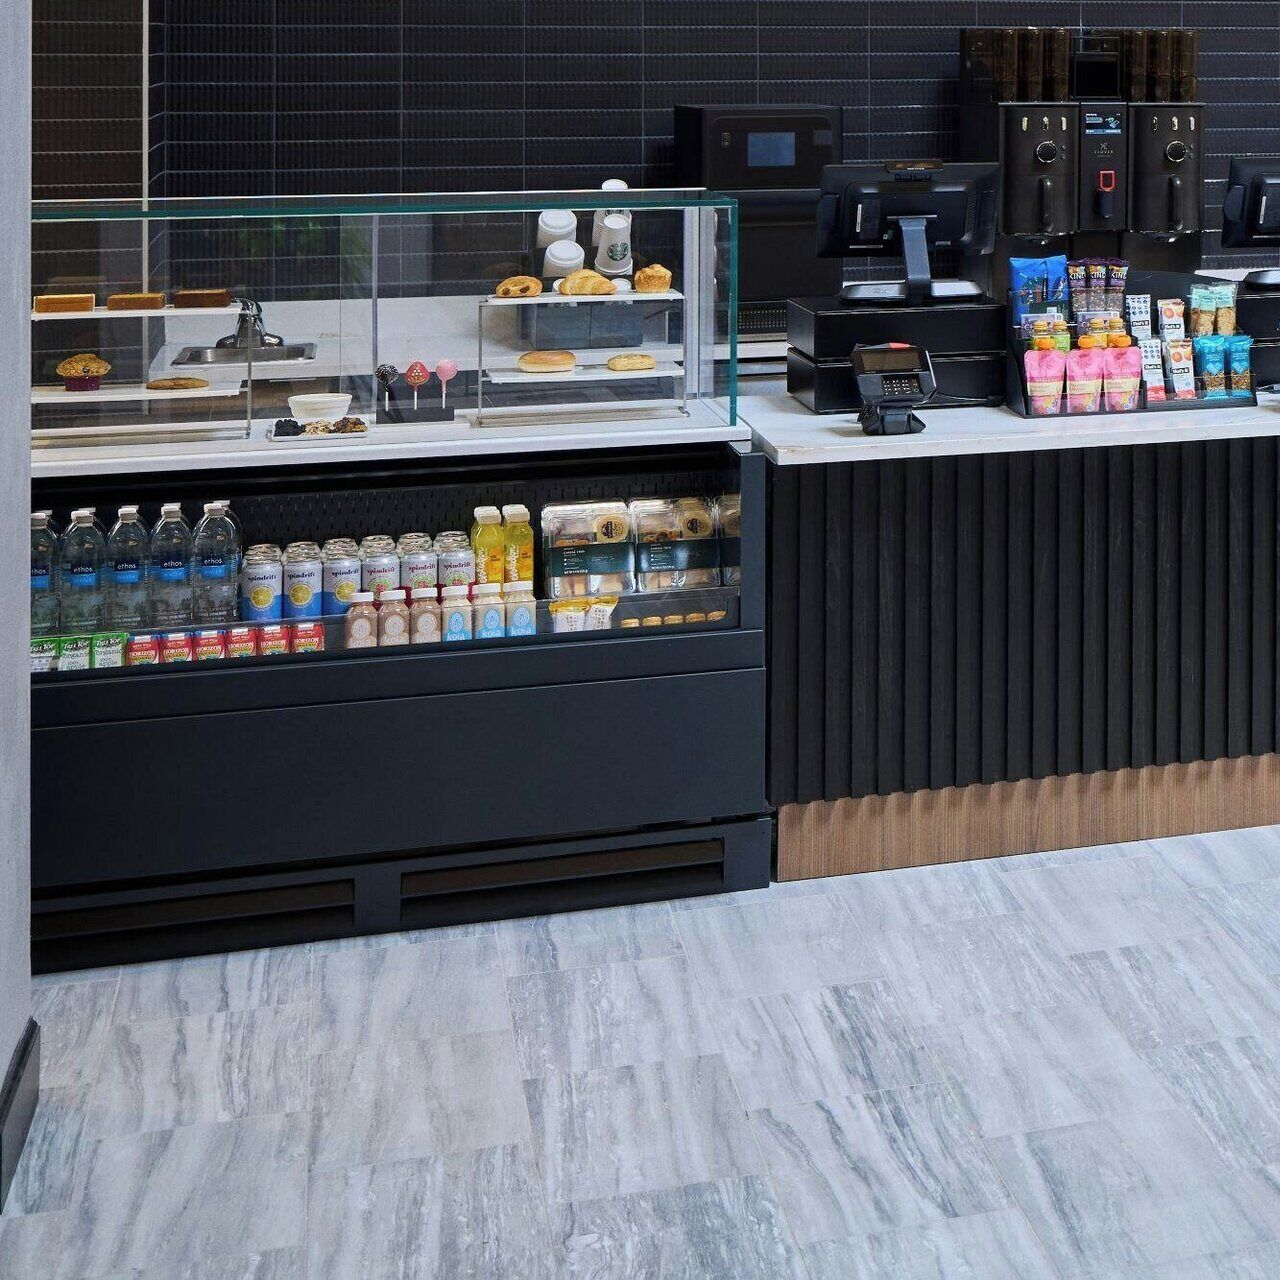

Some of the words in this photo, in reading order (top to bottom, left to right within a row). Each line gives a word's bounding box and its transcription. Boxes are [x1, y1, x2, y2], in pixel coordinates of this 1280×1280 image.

[408, 562, 436, 573] spindrift
[443, 561, 471, 571] spindrift
[248, 574, 277, 583] spindrift
[287, 572, 315, 580] spindrift
[482, 629, 502, 638] koia
[511, 628, 532, 636] koia
[446, 633, 466, 641] koia
